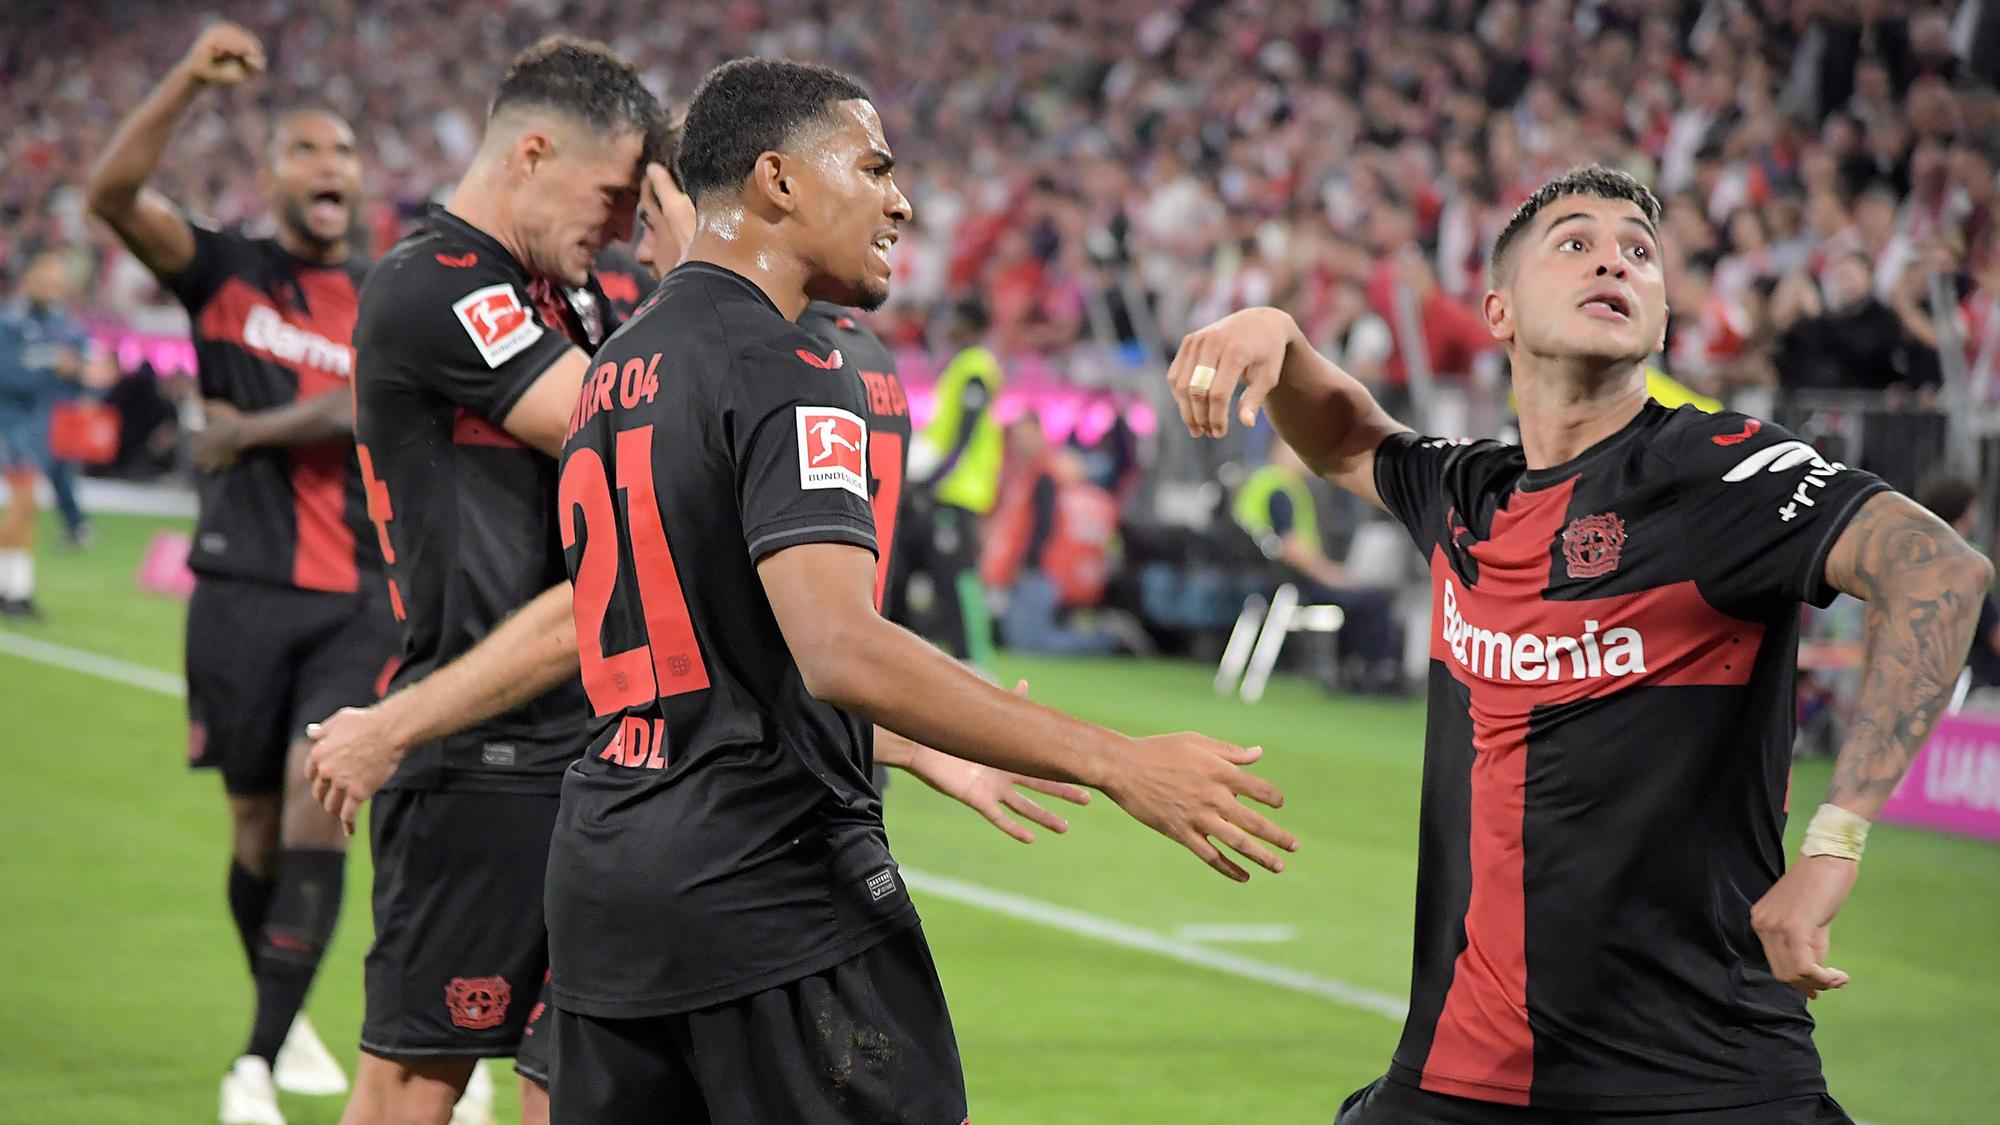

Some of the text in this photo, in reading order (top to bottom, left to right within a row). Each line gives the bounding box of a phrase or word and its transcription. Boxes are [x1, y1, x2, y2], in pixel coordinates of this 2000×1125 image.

[620, 353, 663, 410] 04
[808, 471, 864, 491] BUNDESLIGA
[558, 424, 710, 717] 21
[1443, 578, 1647, 681] Barmenia
[598, 716, 668, 770] ADL
